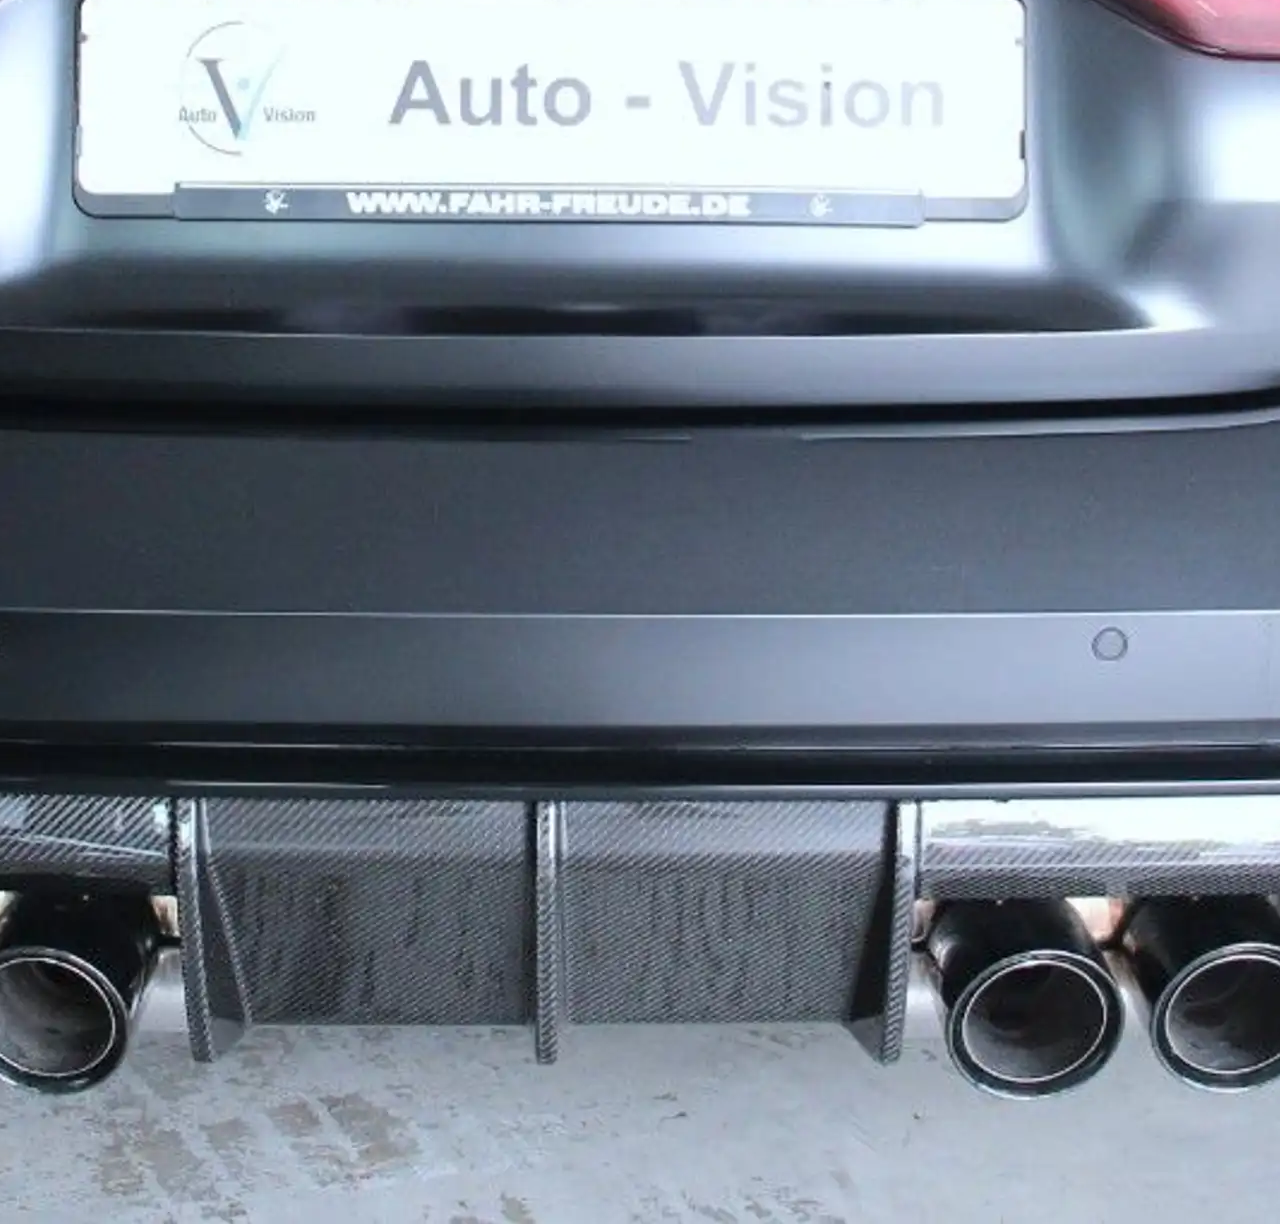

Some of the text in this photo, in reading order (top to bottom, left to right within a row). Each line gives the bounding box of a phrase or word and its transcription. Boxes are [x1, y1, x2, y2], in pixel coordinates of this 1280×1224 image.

[388, 59, 945, 128] Auto - Vision
[178, 105, 317, 124] Auto Vision
[346, 191, 752, 217] WWW.FAHR-FREUDE.DE
